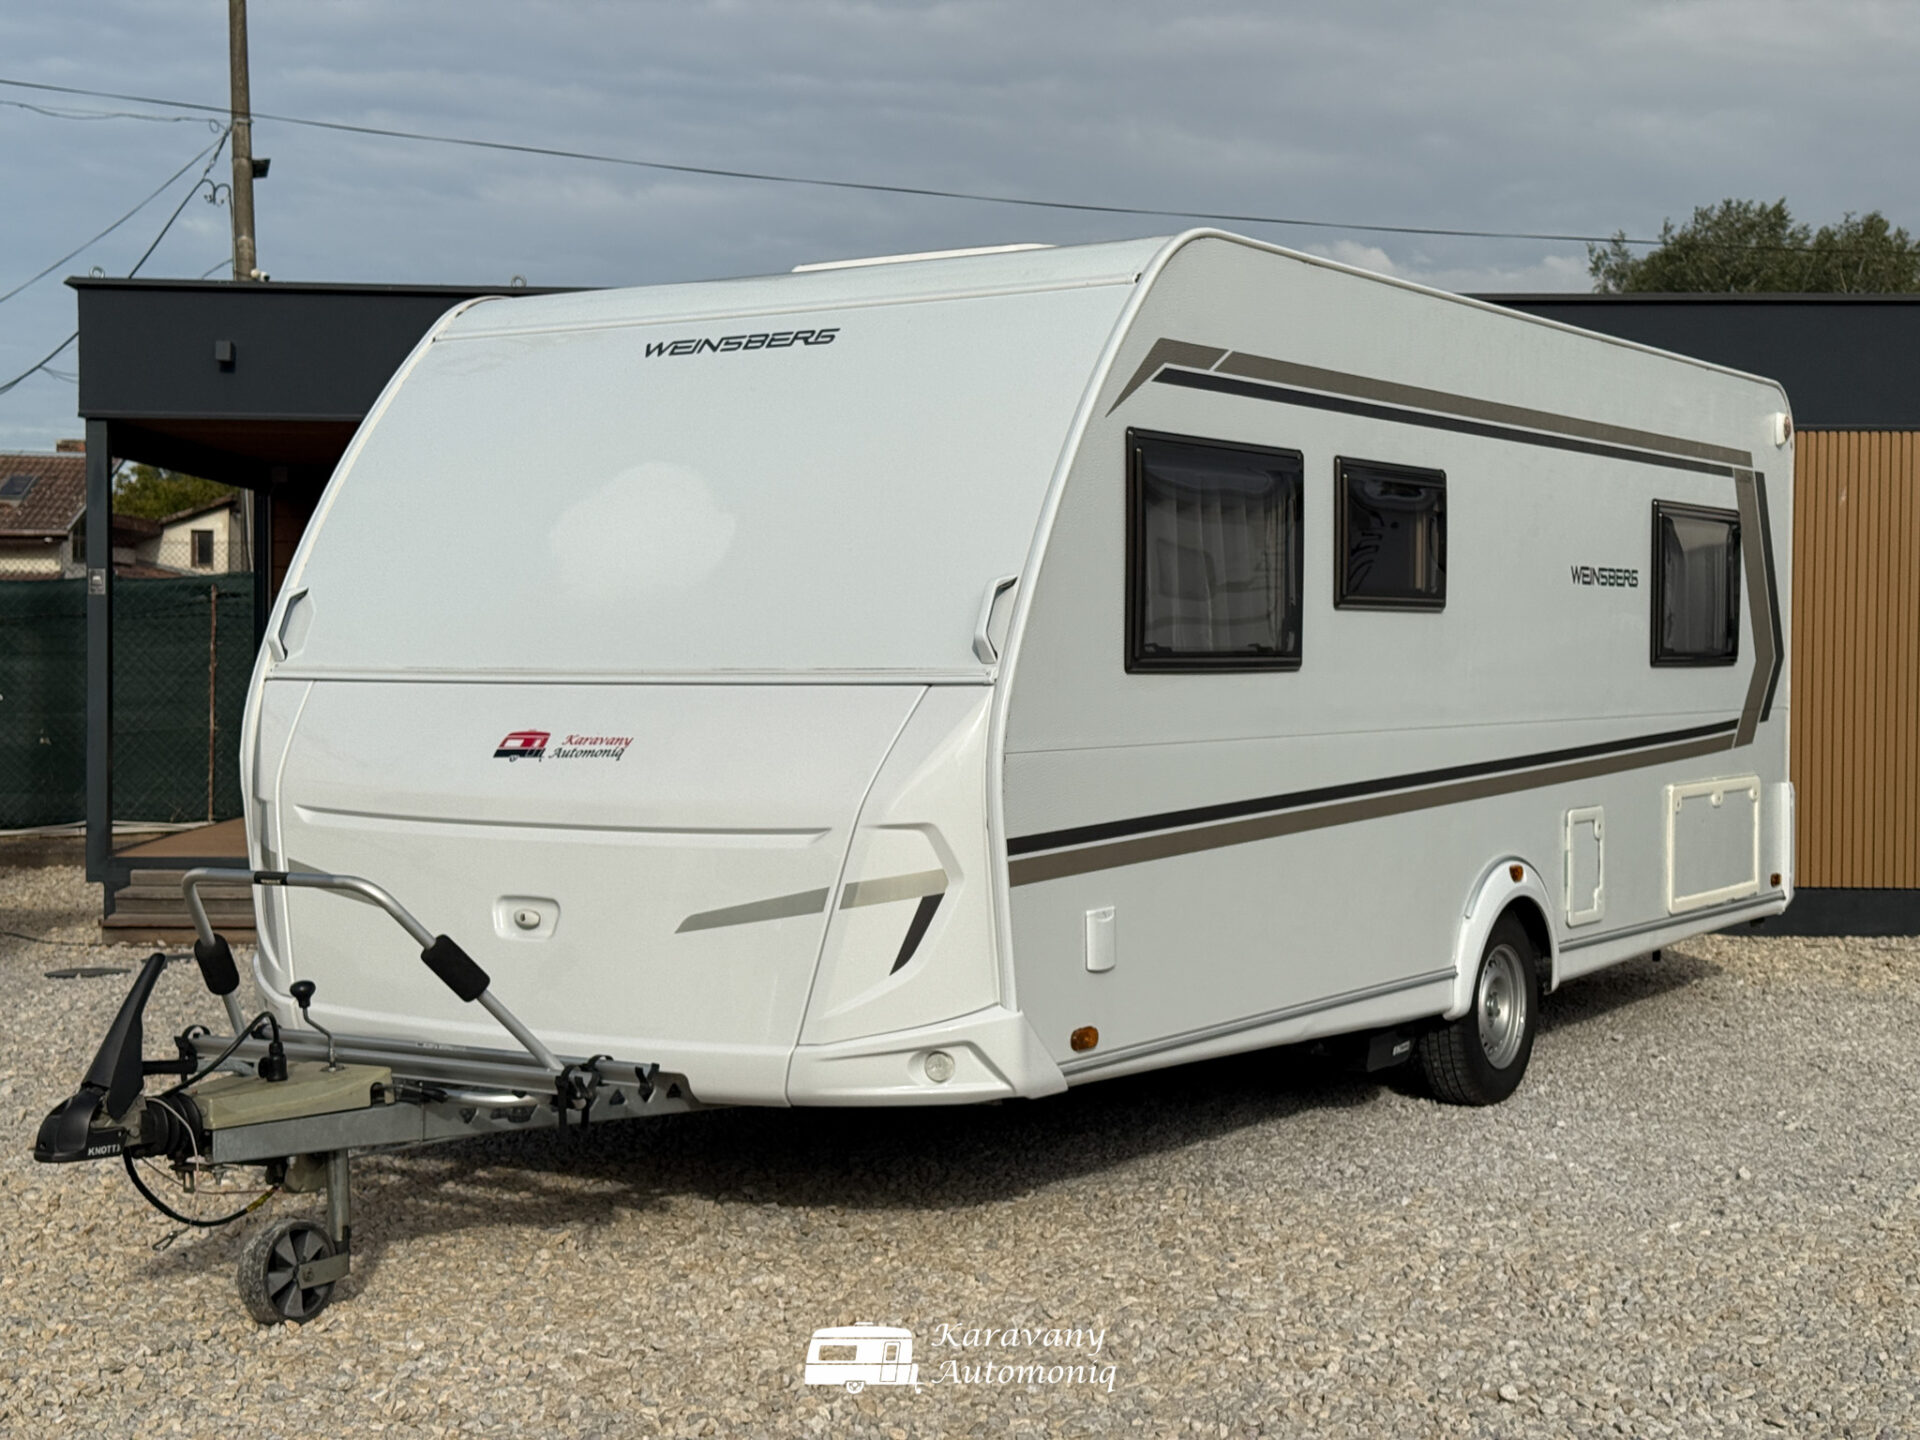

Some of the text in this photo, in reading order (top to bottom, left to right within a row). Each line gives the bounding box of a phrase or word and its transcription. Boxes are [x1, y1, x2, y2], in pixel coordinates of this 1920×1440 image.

[645, 327, 841, 358] WEINSBERG
[1570, 565, 1639, 588] WEINSBERG
[562, 733, 634, 748] Karavany
[549, 746, 625, 761] Automoniq
